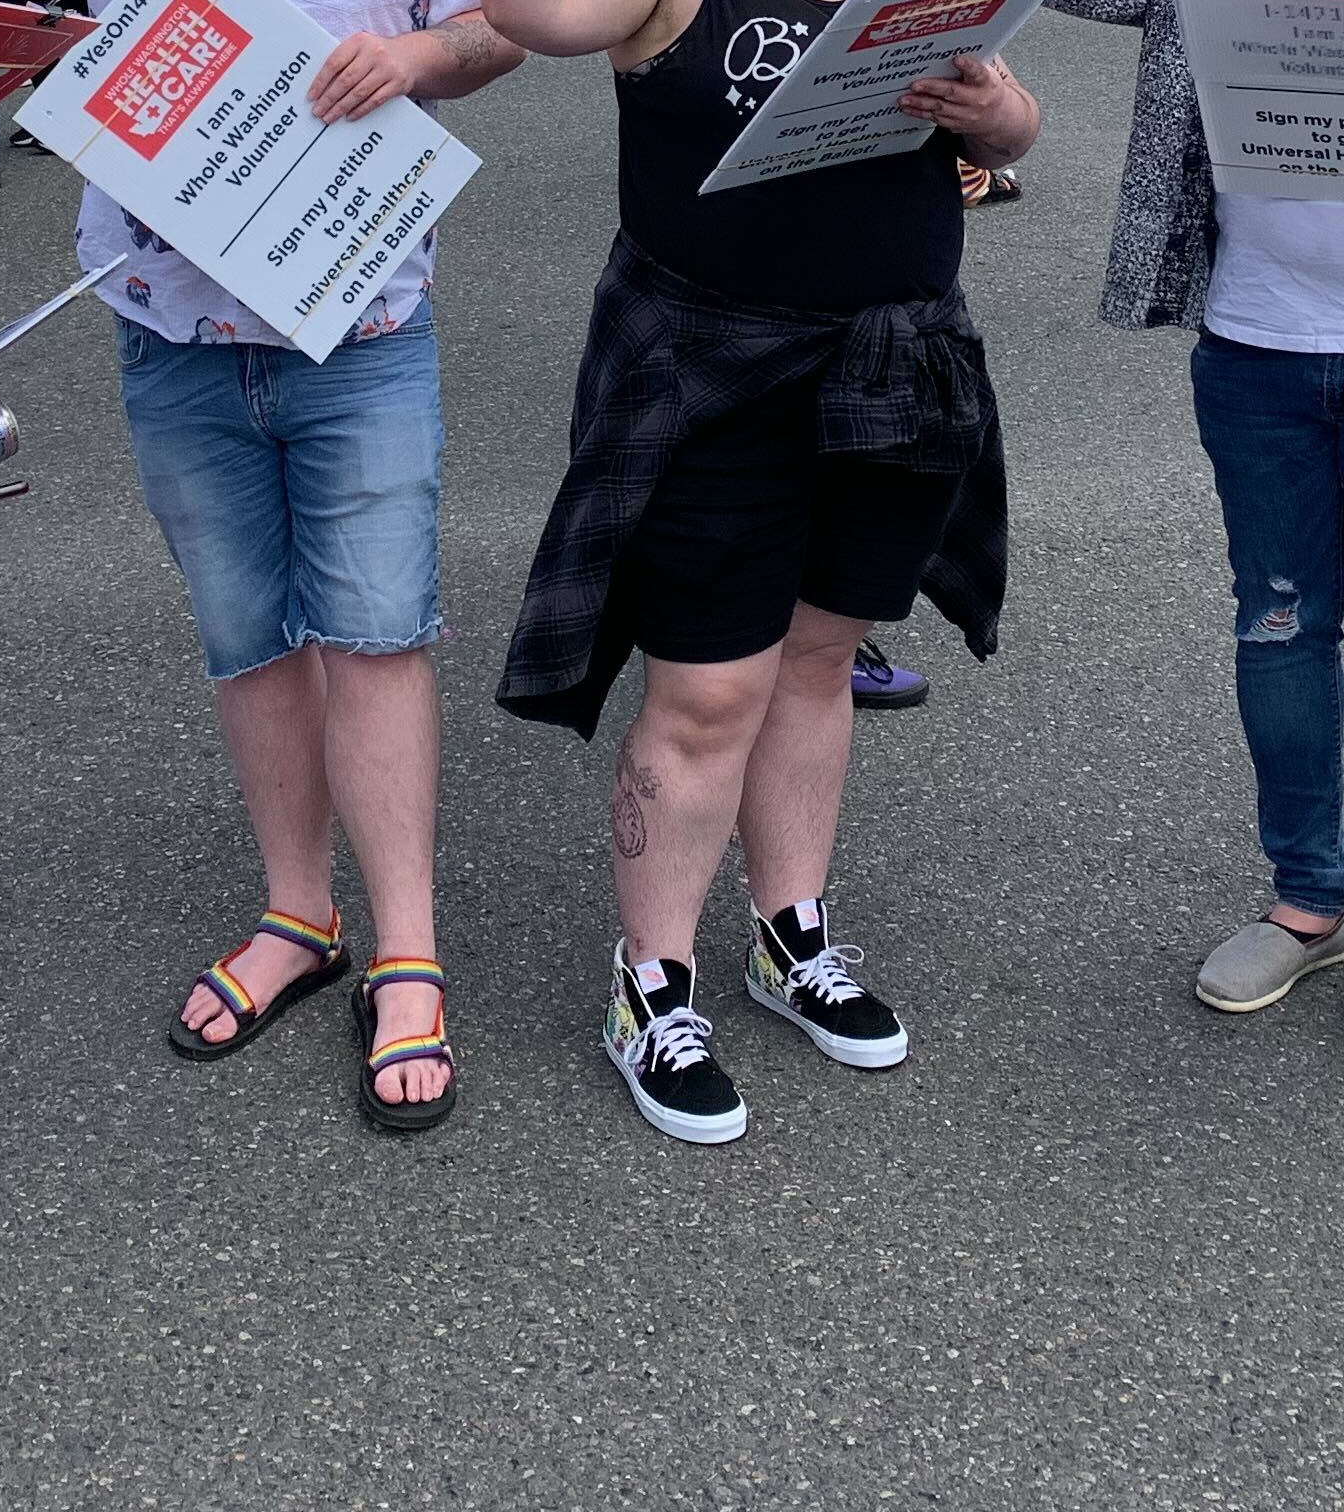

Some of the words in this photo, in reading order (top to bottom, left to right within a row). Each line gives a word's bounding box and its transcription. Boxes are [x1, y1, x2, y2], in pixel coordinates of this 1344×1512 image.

[910, 5, 989, 32] CARE
[104, 66, 137, 101] WHOLE
[132, 3, 190, 69] WASHINGTON
[113, 10, 208, 117] HEALTH
[160, 26, 228, 101] CARE
[813, 67, 870, 85] Whole
[877, 43, 983, 71] Washington
[891, 45, 918, 57] am
[920, 42, 934, 51] a
[158, 102, 186, 136] THAT'S
[183, 68, 216, 105] ALWAYS
[212, 41, 238, 73] THERE
[842, 66, 928, 90] Volunteer
[174, 149, 229, 207] Whole
[222, 49, 311, 150] Washington
[197, 125, 211, 141] I
[207, 99, 235, 132] am
[234, 87, 246, 102] a
[775, 123, 818, 140] Sign
[819, 115, 850, 131] my
[853, 105, 906, 125] petiti
[815, 131, 835, 142] to
[836, 123, 869, 139] get
[1255, 111, 1299, 126] Sign
[1304, 115, 1333, 129] my
[1312, 132, 1332, 144] to
[224, 104, 299, 188] Volunteer
[759, 164, 783, 176] on
[785, 156, 817, 172] the
[819, 143, 879, 163] Ballot!
[1241, 143, 1331, 161] Universal
[267, 224, 305, 268] Sign
[301, 196, 329, 230] my
[324, 129, 384, 203] petition
[323, 218, 345, 241] to
[343, 185, 373, 222] get
[294, 235, 364, 318] Universal
[358, 146, 436, 239] Healthcare
[342, 278, 364, 305] on
[358, 248, 389, 284] the
[382, 189, 436, 251] Ballot!
